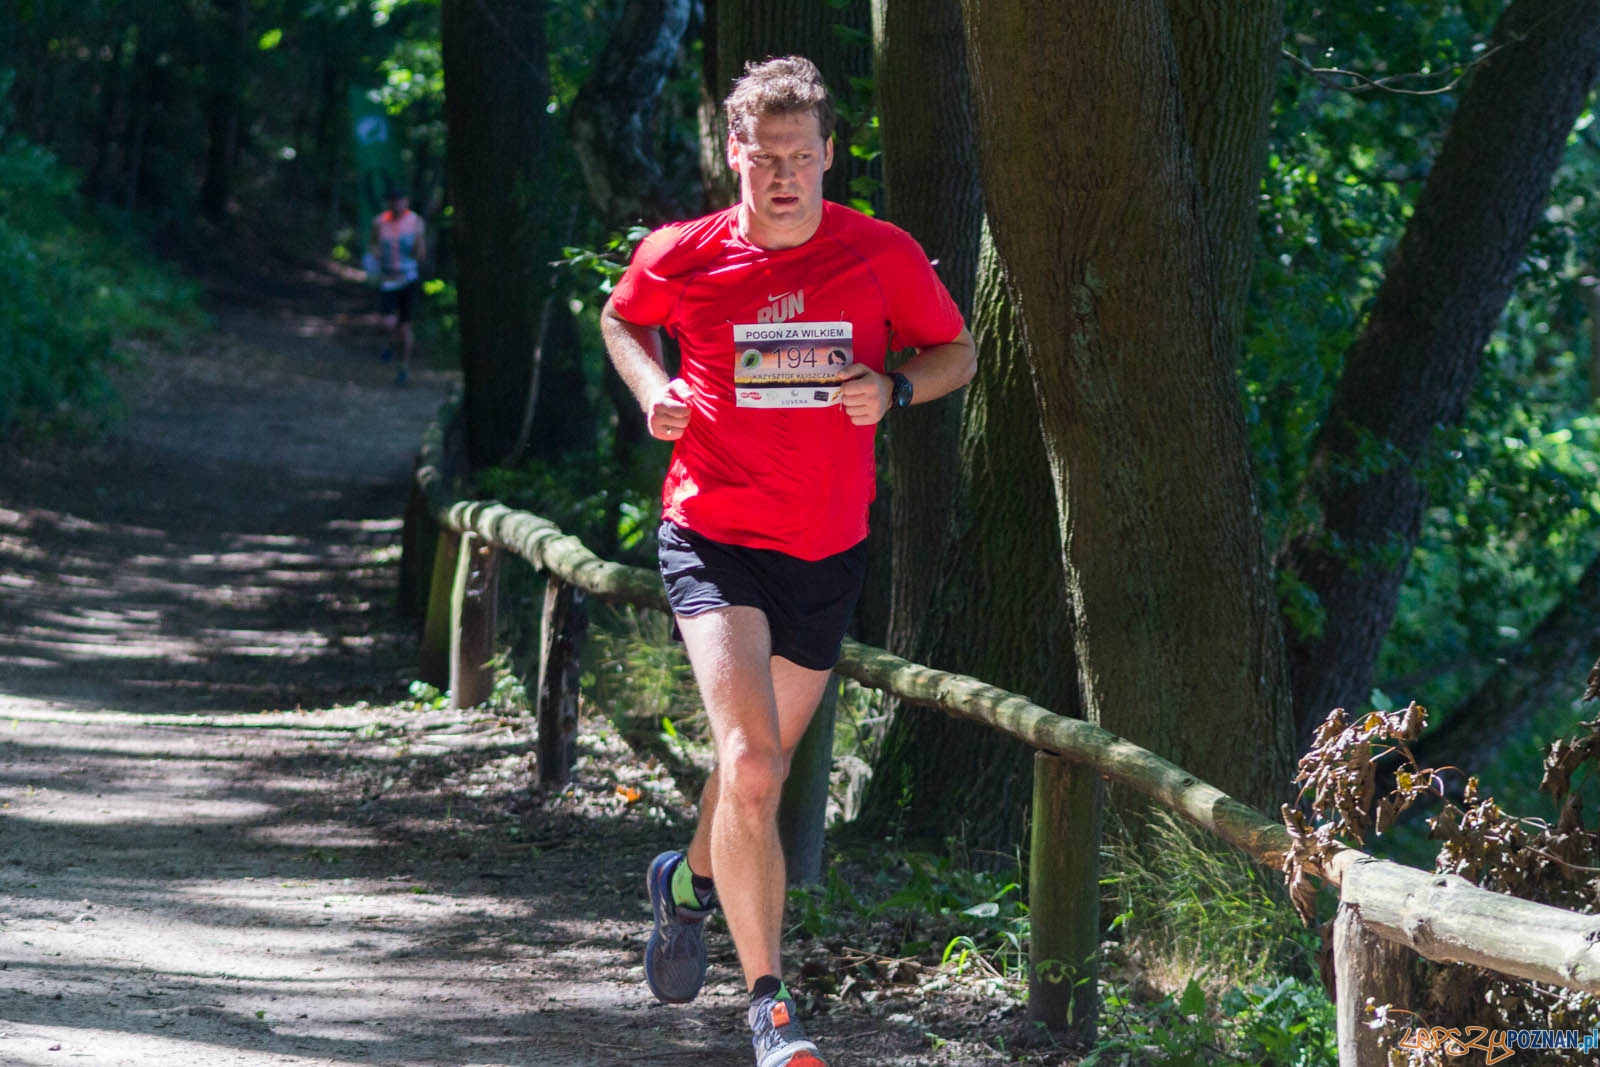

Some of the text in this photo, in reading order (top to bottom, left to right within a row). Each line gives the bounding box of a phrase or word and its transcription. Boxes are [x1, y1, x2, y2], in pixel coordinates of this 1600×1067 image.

[757, 289, 804, 324] RUN
[785, 330, 799, 338] ZA
[801, 329, 844, 338] WILKIEM
[773, 347, 817, 369] 194
